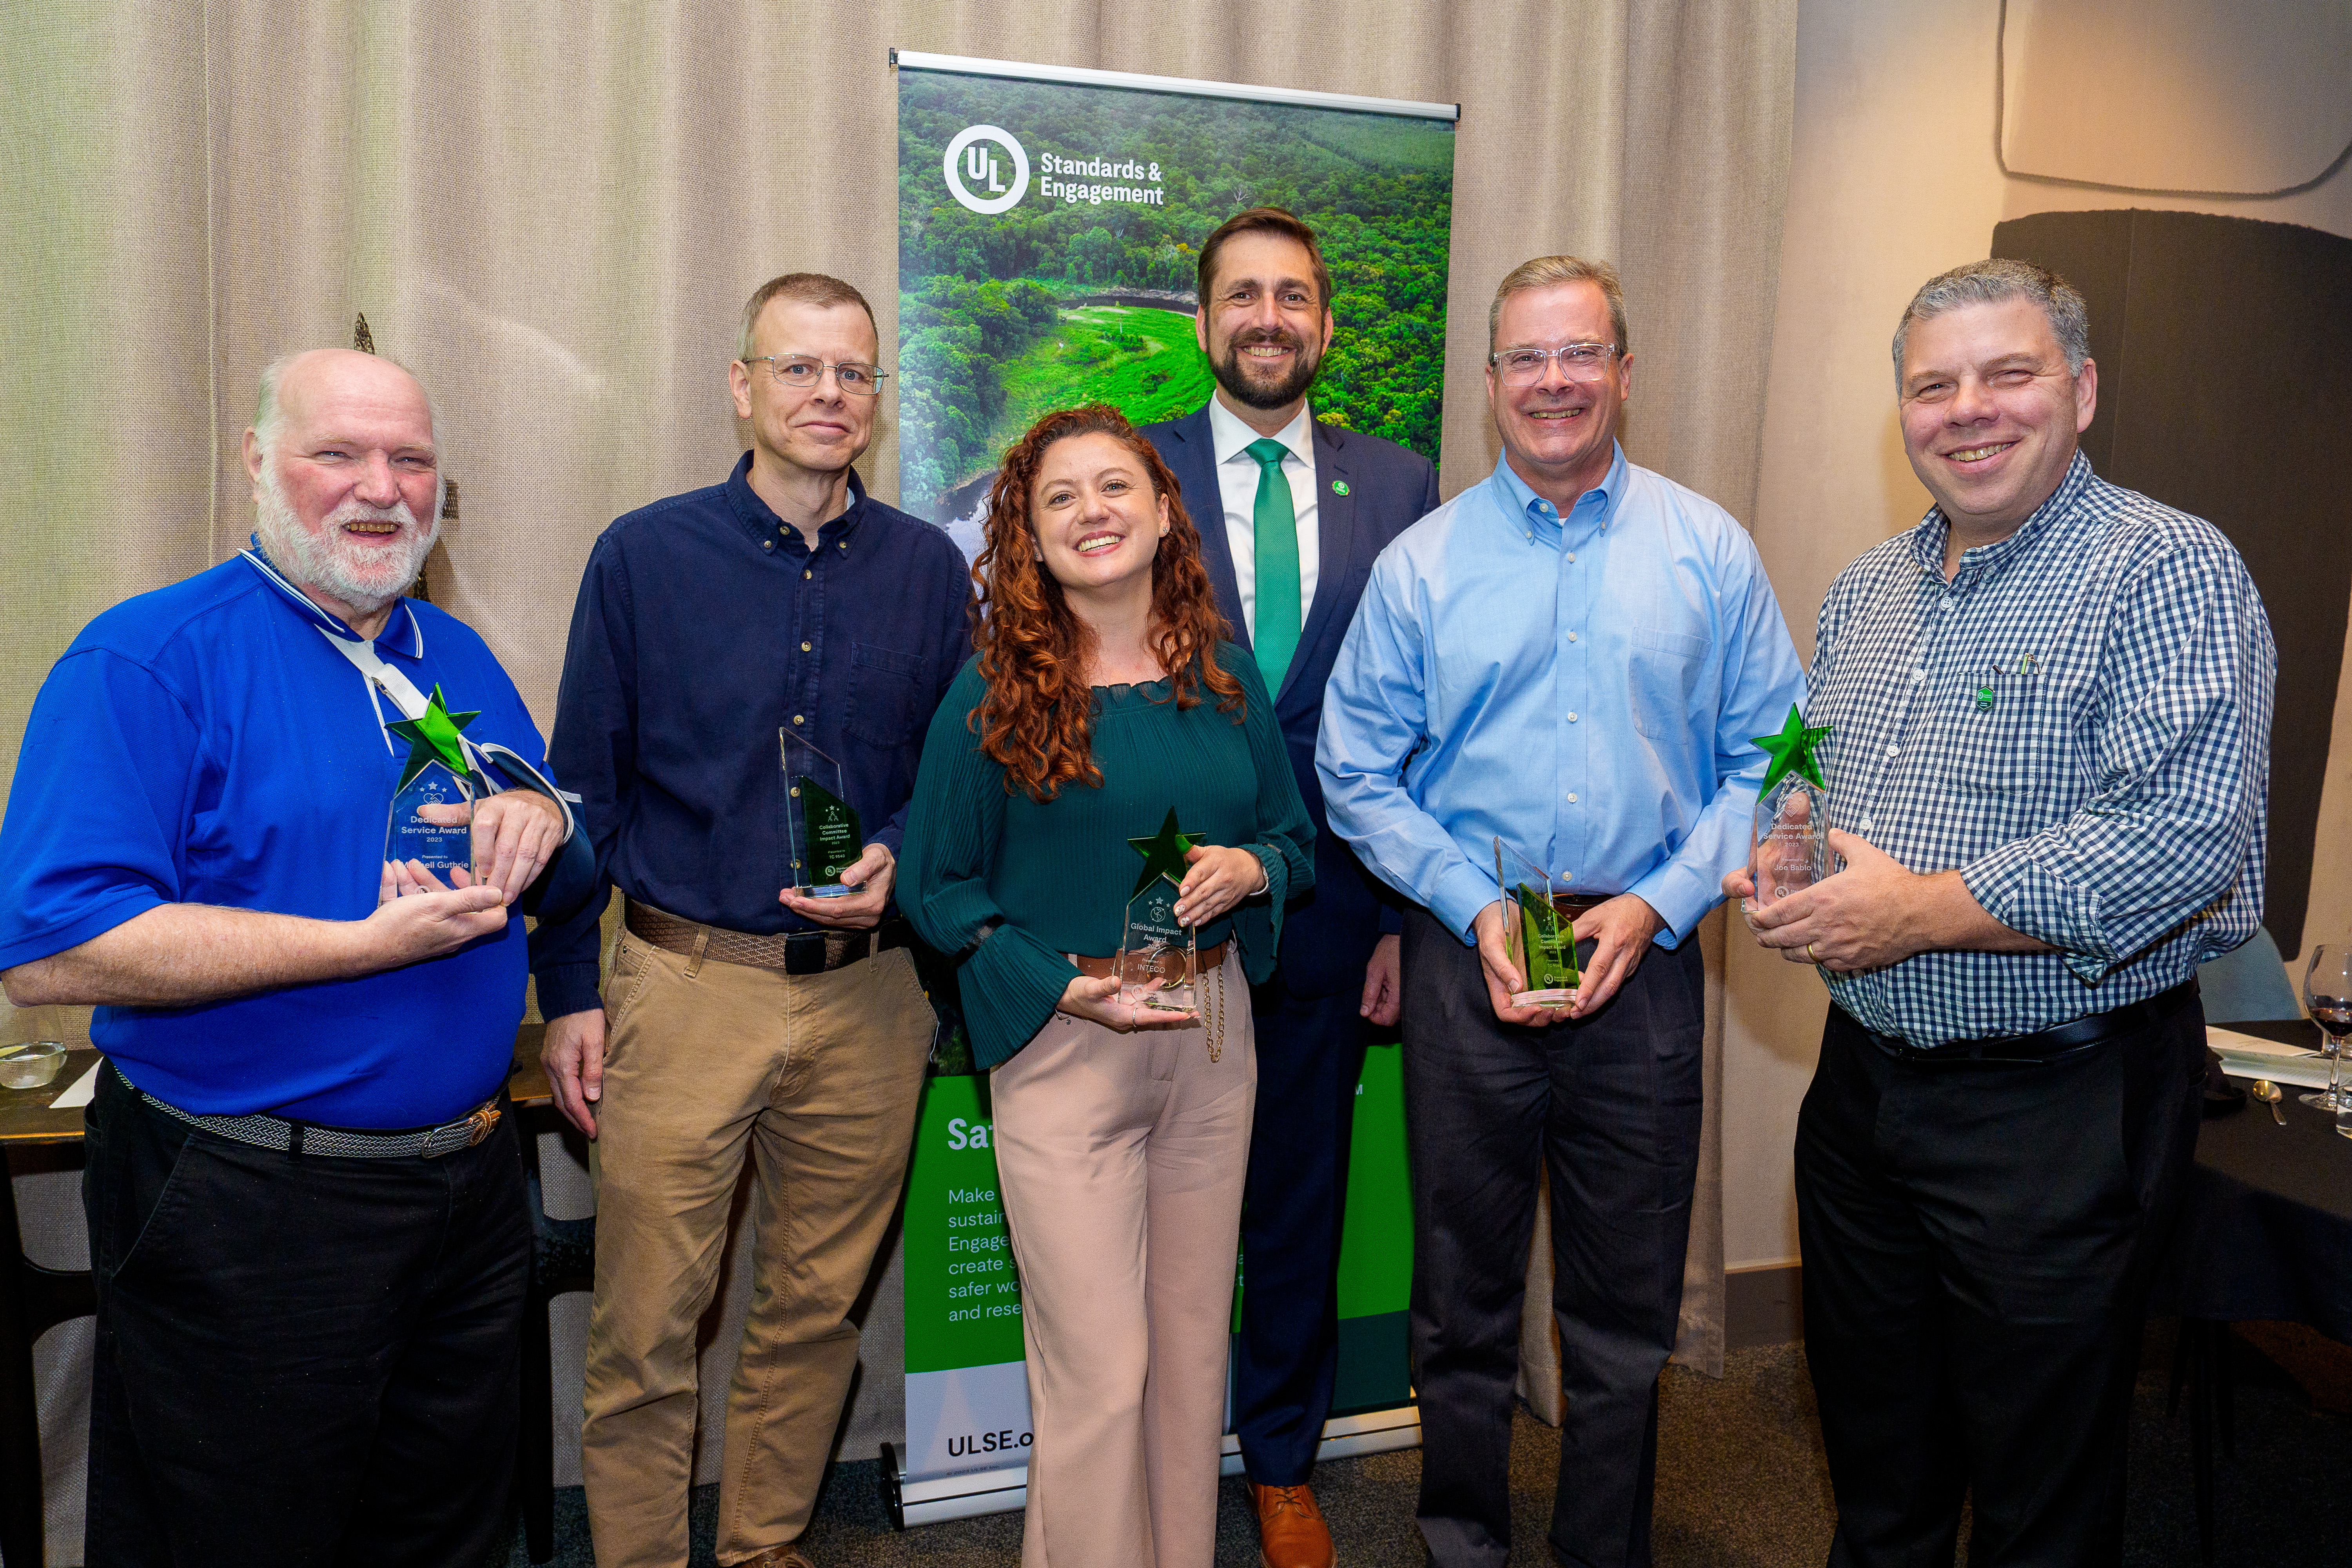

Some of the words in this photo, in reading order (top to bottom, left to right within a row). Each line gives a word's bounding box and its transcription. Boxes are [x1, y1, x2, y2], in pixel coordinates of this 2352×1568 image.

[968, 146, 1005, 192] UL
[1041, 153, 1145, 180] Standards
[1149, 162, 1162, 181] &
[1041, 176, 1164, 205] Engagement
[1131, 923, 1154, 932] Global
[1156, 926, 1182, 935] Impact
[1143, 934, 1167, 943] Award
[1137, 964, 1165, 973] INTECO
[949, 1187, 995, 1204] Make
[949, 1236, 1010, 1253] Engage
[949, 1258, 1003, 1274] create
[949, 1281, 991, 1298] safer
[949, 1304, 980, 1321] and
